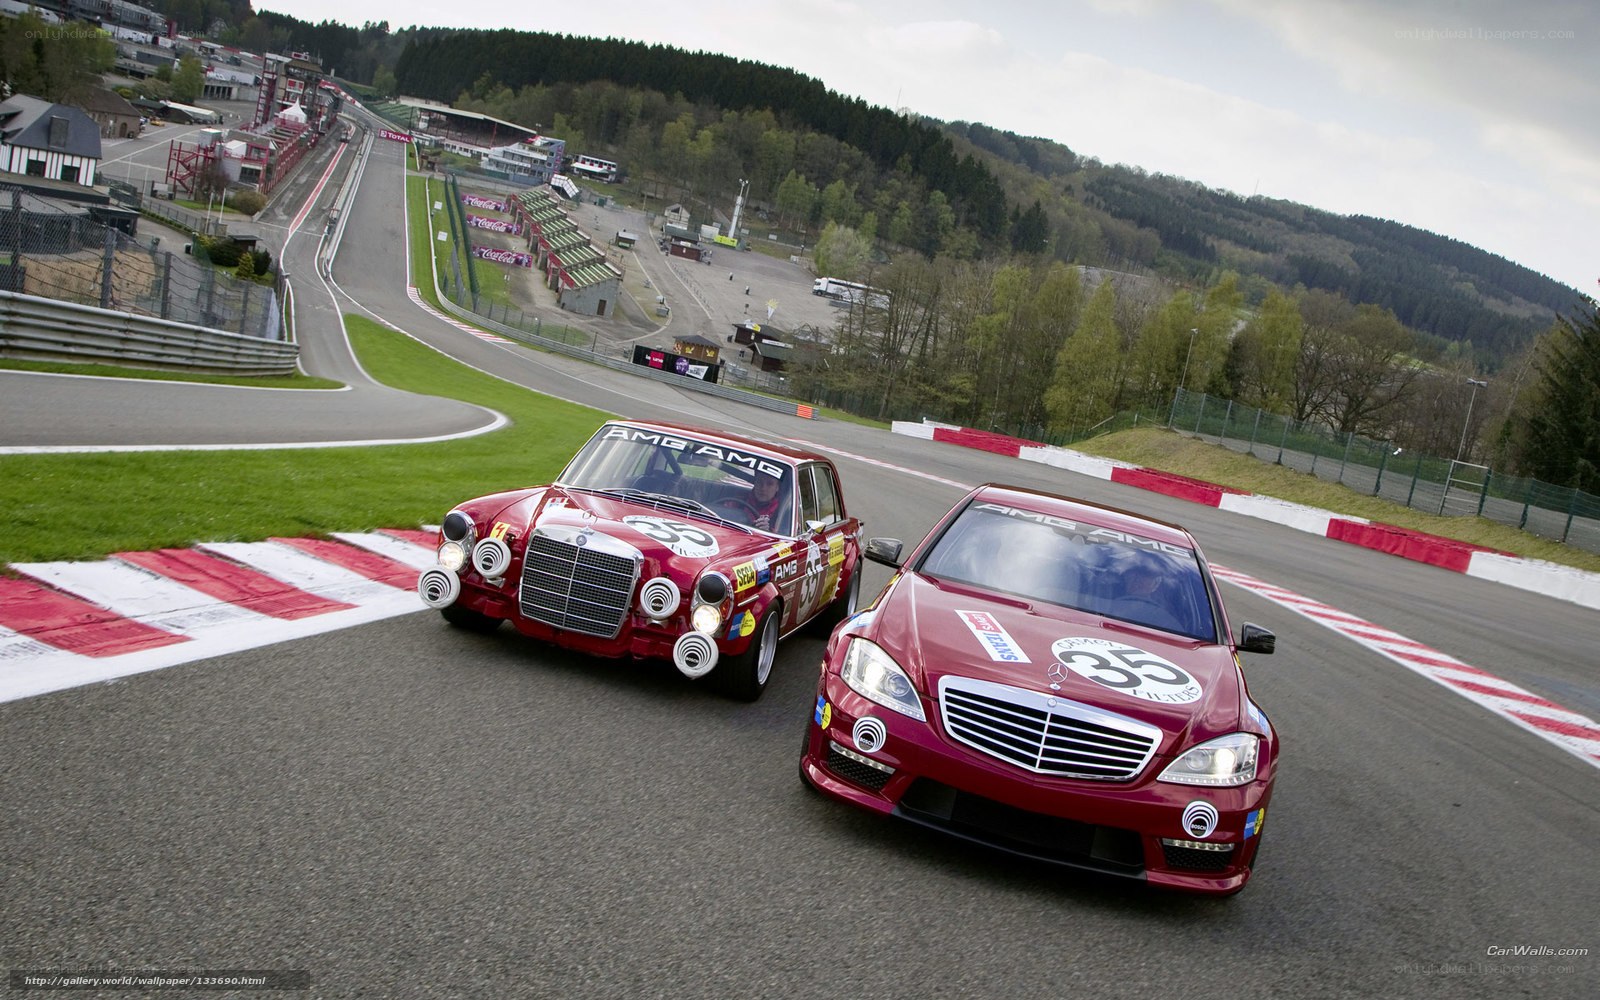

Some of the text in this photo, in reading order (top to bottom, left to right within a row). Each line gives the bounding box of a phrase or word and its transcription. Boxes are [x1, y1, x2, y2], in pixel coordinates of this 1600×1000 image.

[387, 132, 410, 143] TOTAL
[602, 429, 784, 479] AMG AMG
[626, 520, 714, 547] 35
[974, 503, 1191, 558] AMG AMG
[775, 560, 797, 580] AMG
[983, 632, 1019, 661] JEANS
[1058, 649, 1190, 688] 35
[859, 736, 875, 746] BOSCH
[1190, 822, 1207, 831] BOSCH
